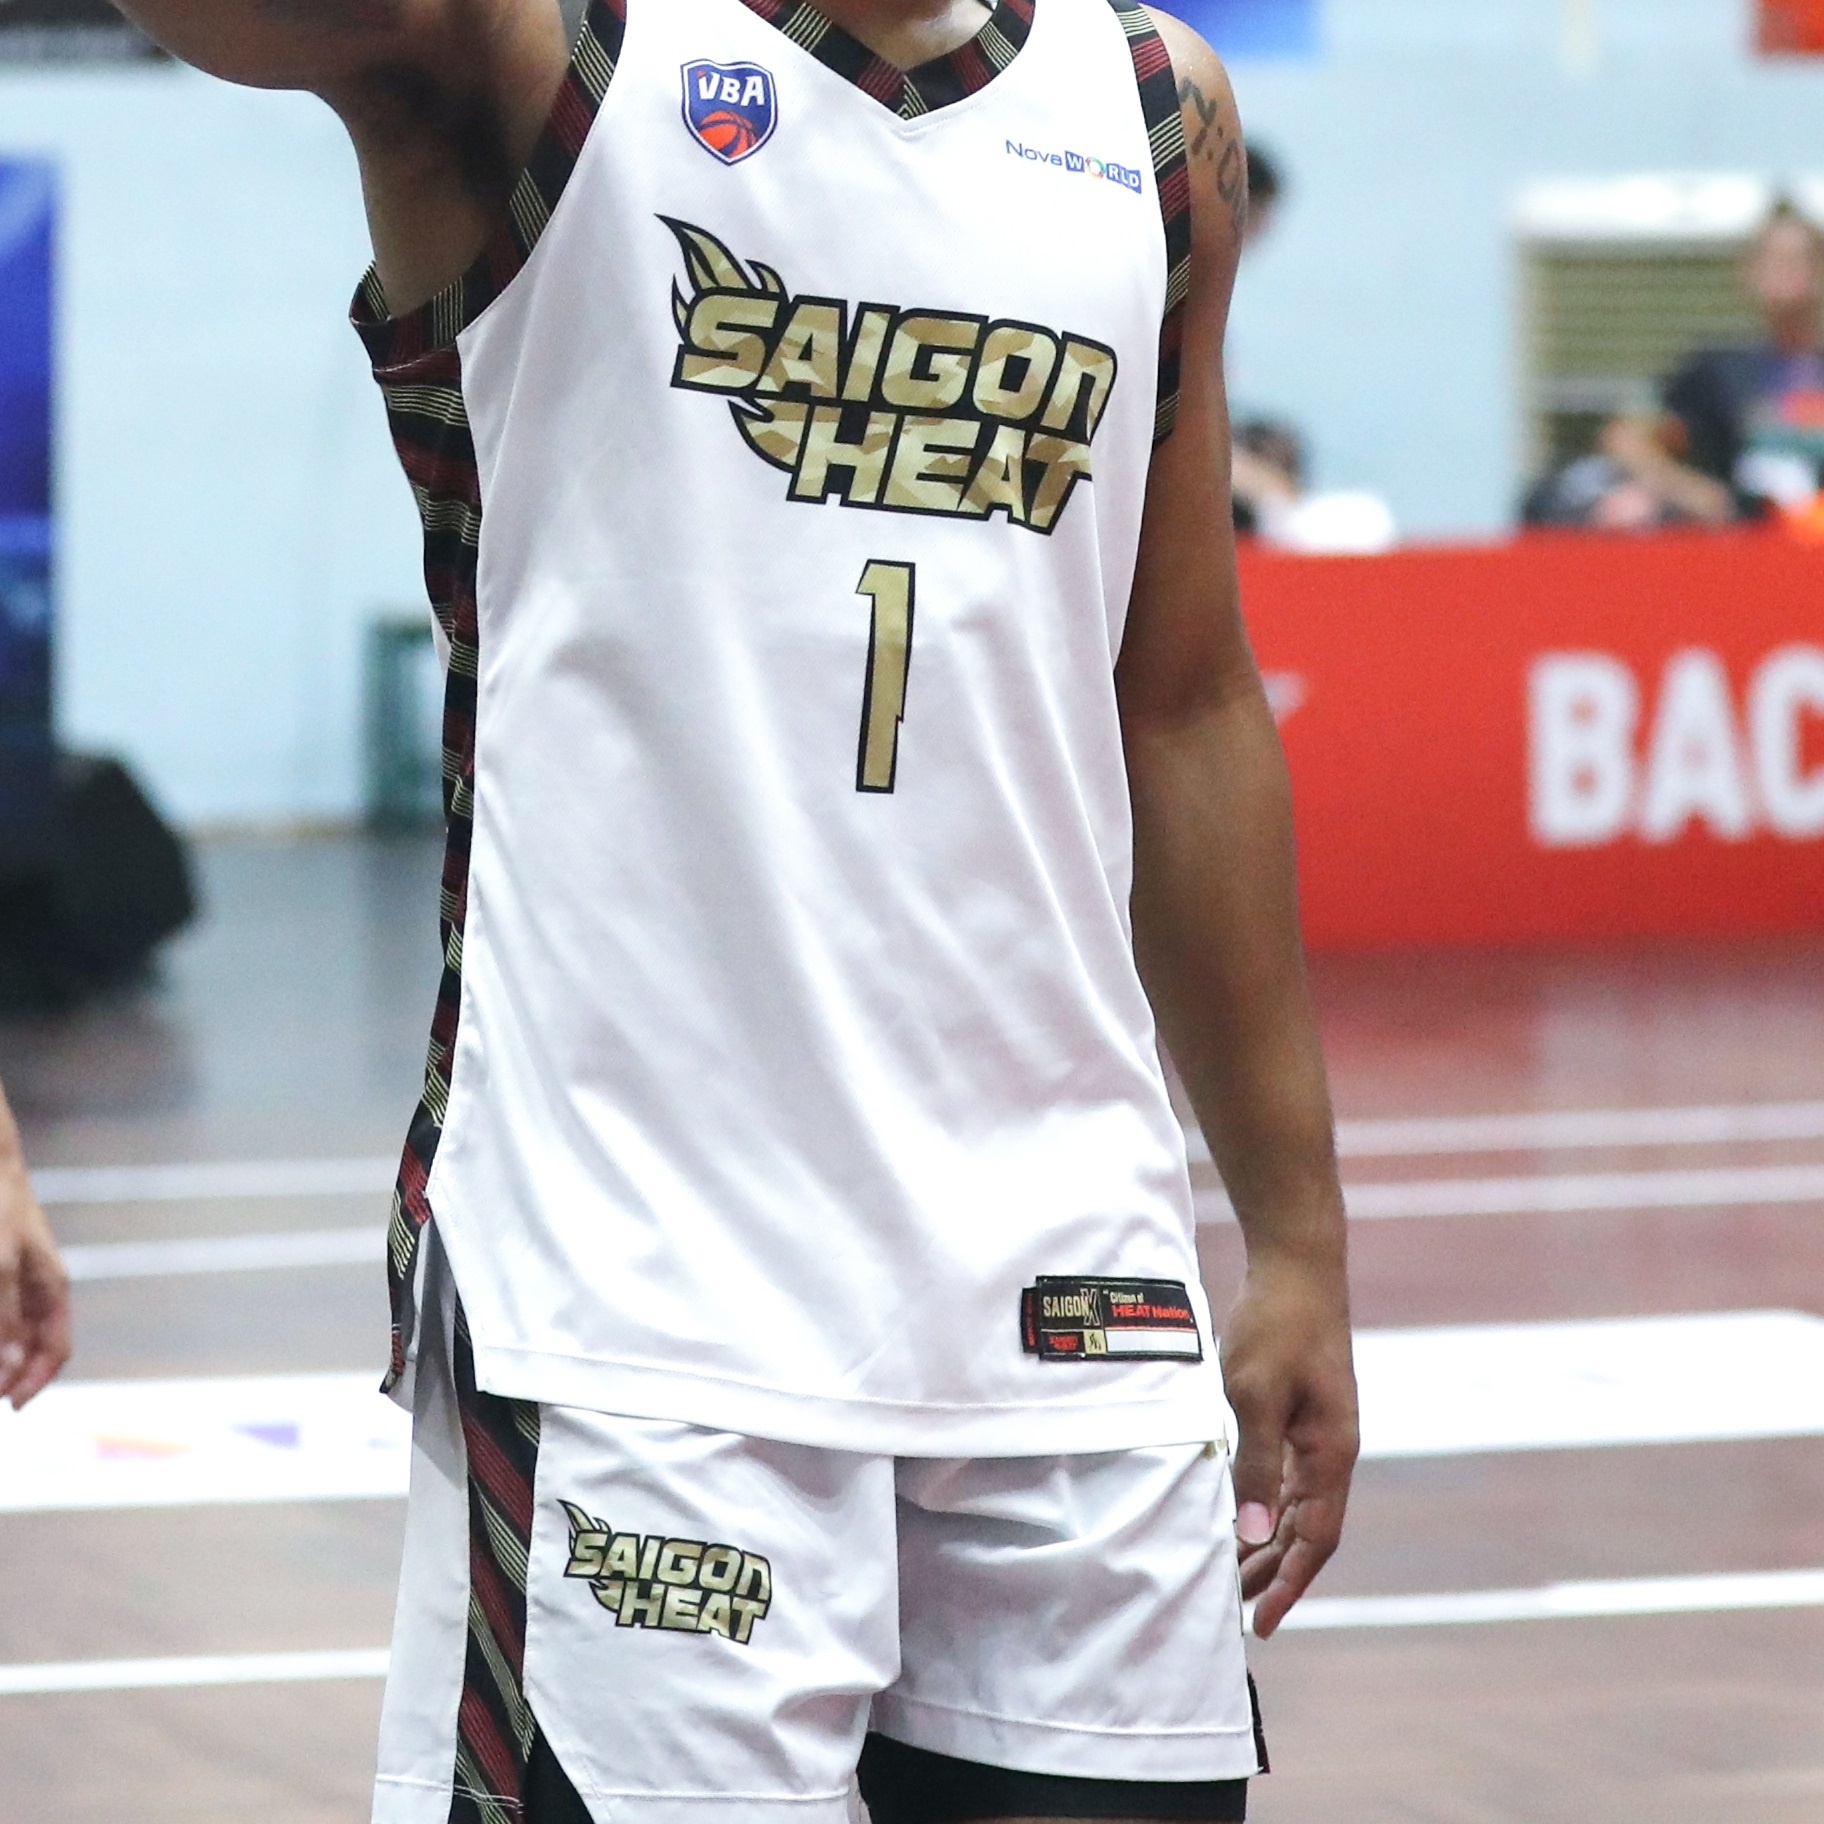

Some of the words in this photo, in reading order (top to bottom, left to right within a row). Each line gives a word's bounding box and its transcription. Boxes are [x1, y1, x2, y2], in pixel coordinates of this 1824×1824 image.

[698, 71, 765, 107] VBA
[671, 287, 1118, 444] SAIGON
[785, 398, 1094, 536] HEAT
[856, 558, 916, 794] 1
[1111, 1304, 1150, 1318] HEAT
[563, 1530, 772, 1603] SAIGON
[614, 1580, 768, 1645] HEAT
